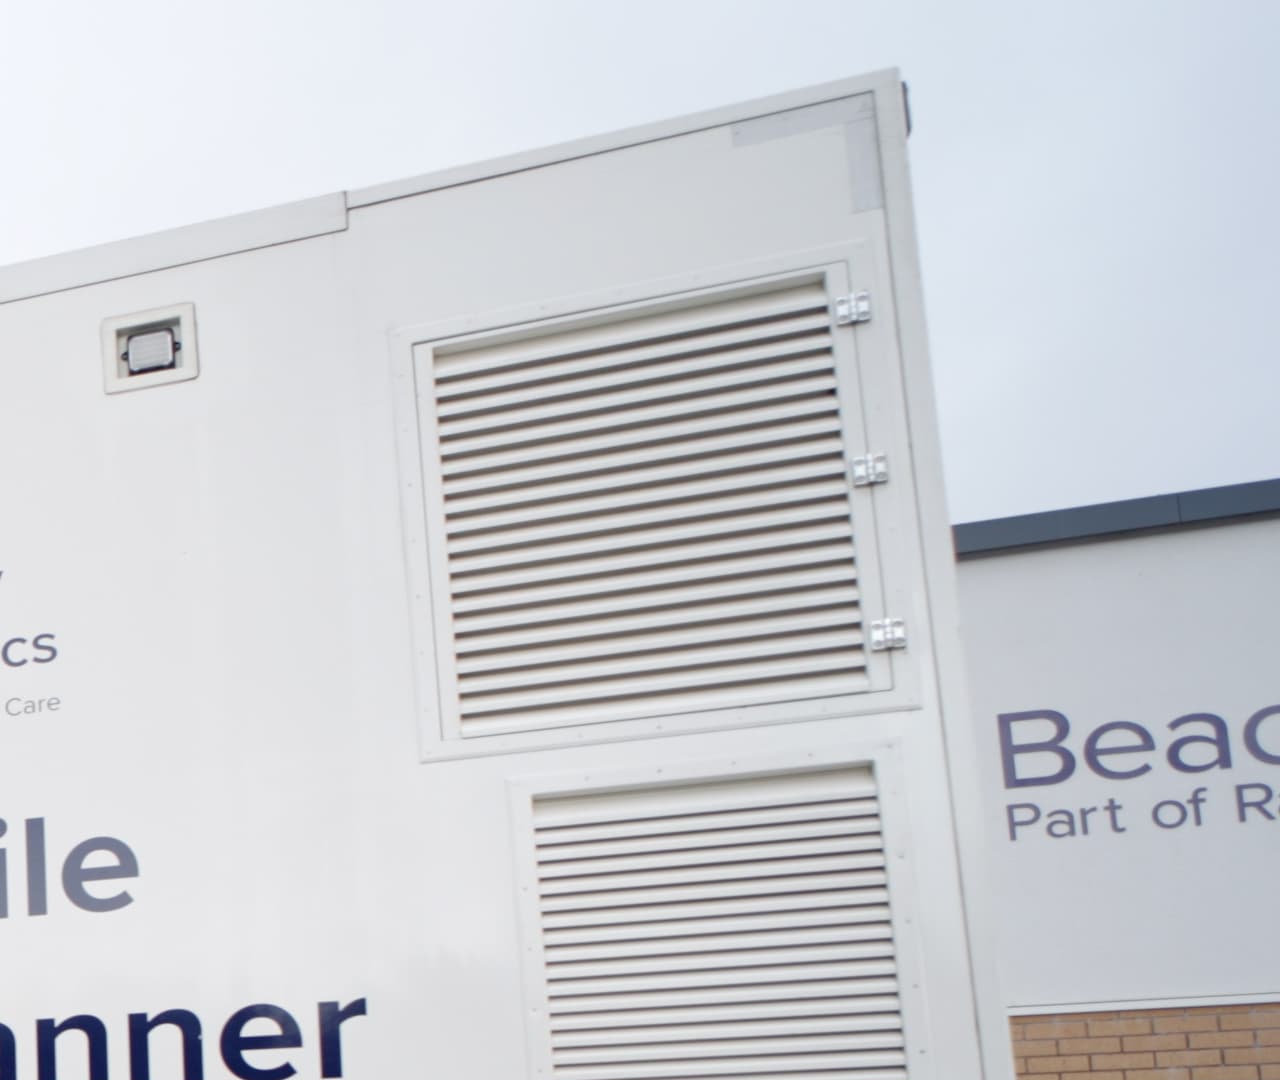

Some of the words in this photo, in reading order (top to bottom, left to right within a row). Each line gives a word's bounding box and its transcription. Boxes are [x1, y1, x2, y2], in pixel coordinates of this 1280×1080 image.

[4, 696, 62, 717] Care
[1005, 797, 1127, 842] Part
[1151, 786, 1208, 830] of
[1235, 782, 1280, 823] R
